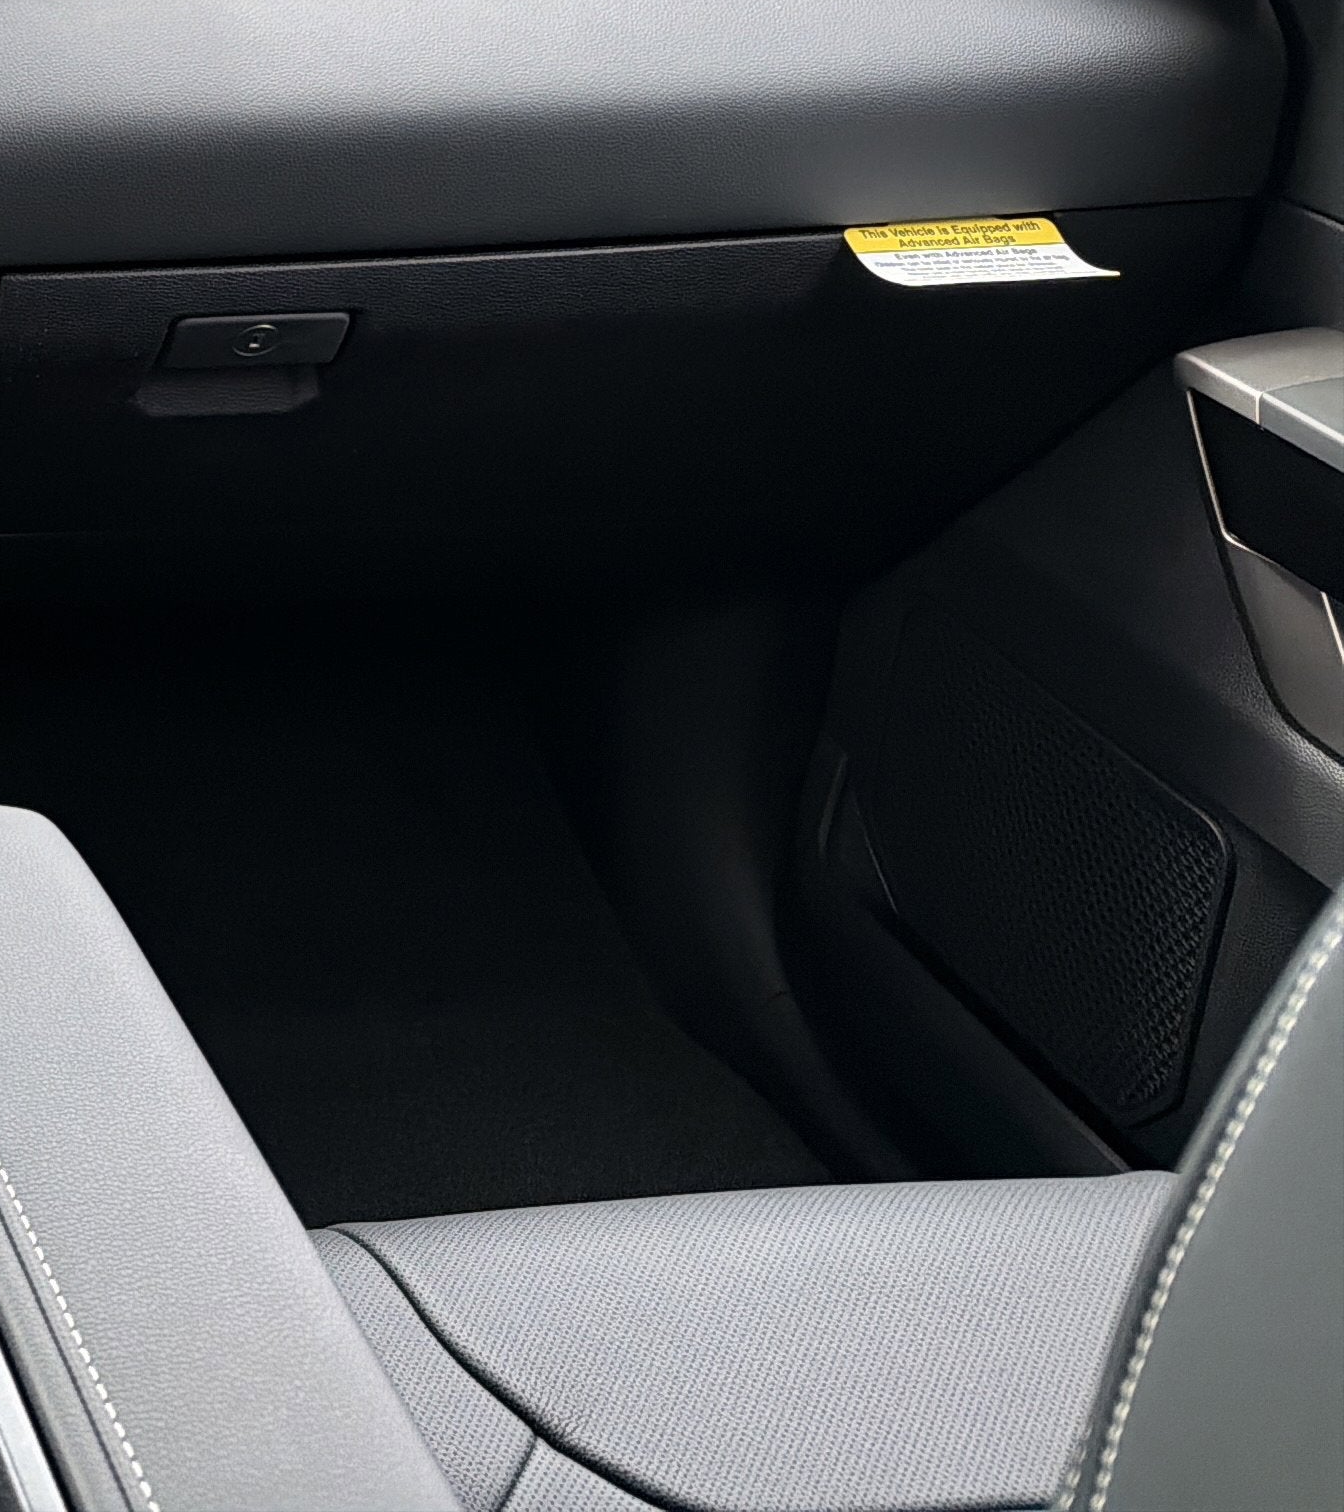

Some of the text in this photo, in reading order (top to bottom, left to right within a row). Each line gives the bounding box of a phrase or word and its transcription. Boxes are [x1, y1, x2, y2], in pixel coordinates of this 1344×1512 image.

[858, 221, 1041, 239] This Vehicle is Equipped with
[898, 234, 1017, 248] Advanced Air Bags
